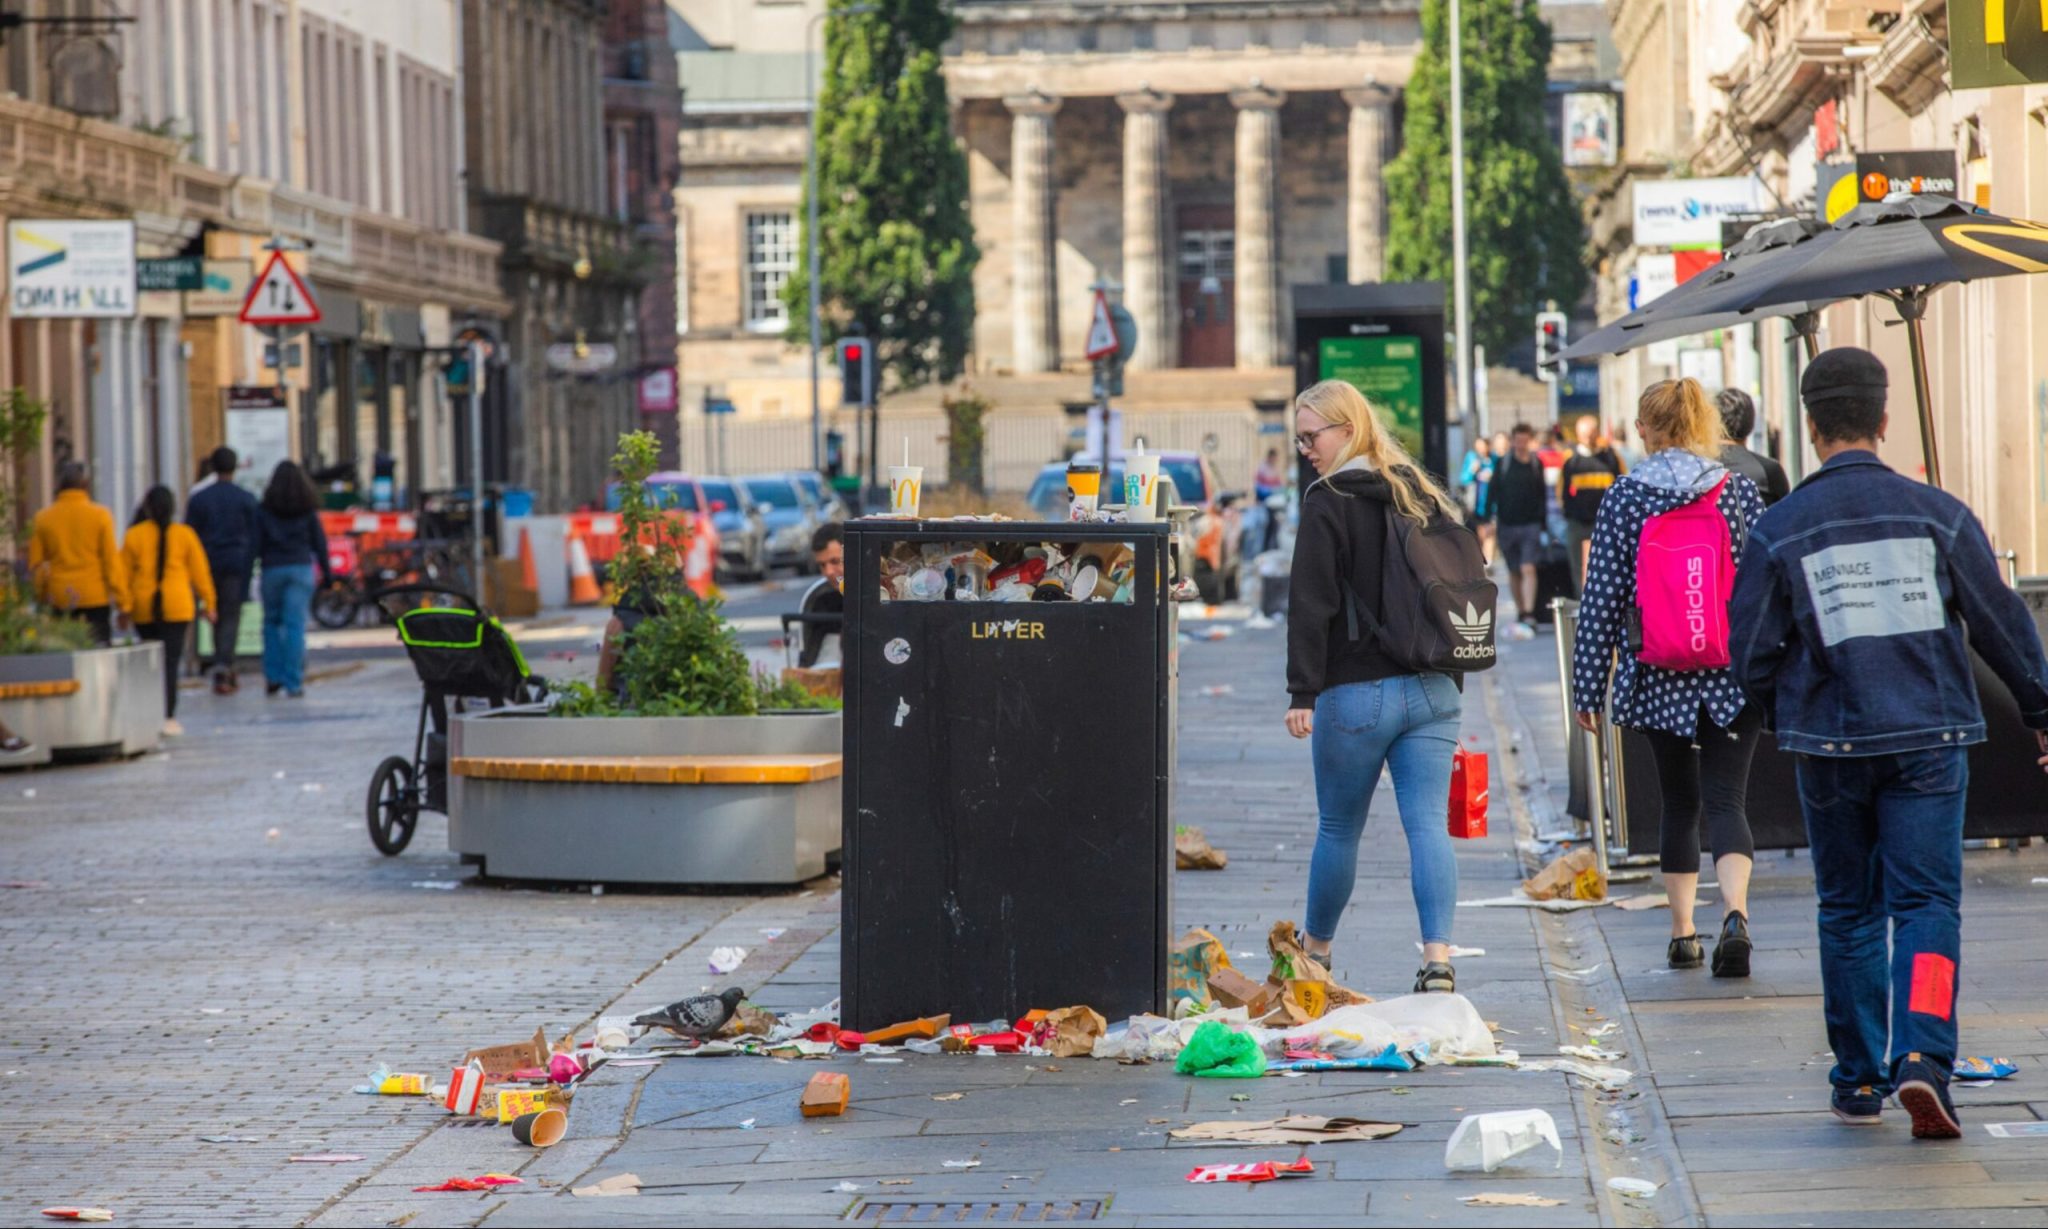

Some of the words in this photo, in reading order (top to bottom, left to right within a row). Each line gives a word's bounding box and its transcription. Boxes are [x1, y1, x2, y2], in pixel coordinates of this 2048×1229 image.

[16, 286, 55, 308] DM
[1876, 578, 1901, 587] PARTY
[1685, 556, 1706, 652] adidas
[1453, 643, 1494, 659] adidas
